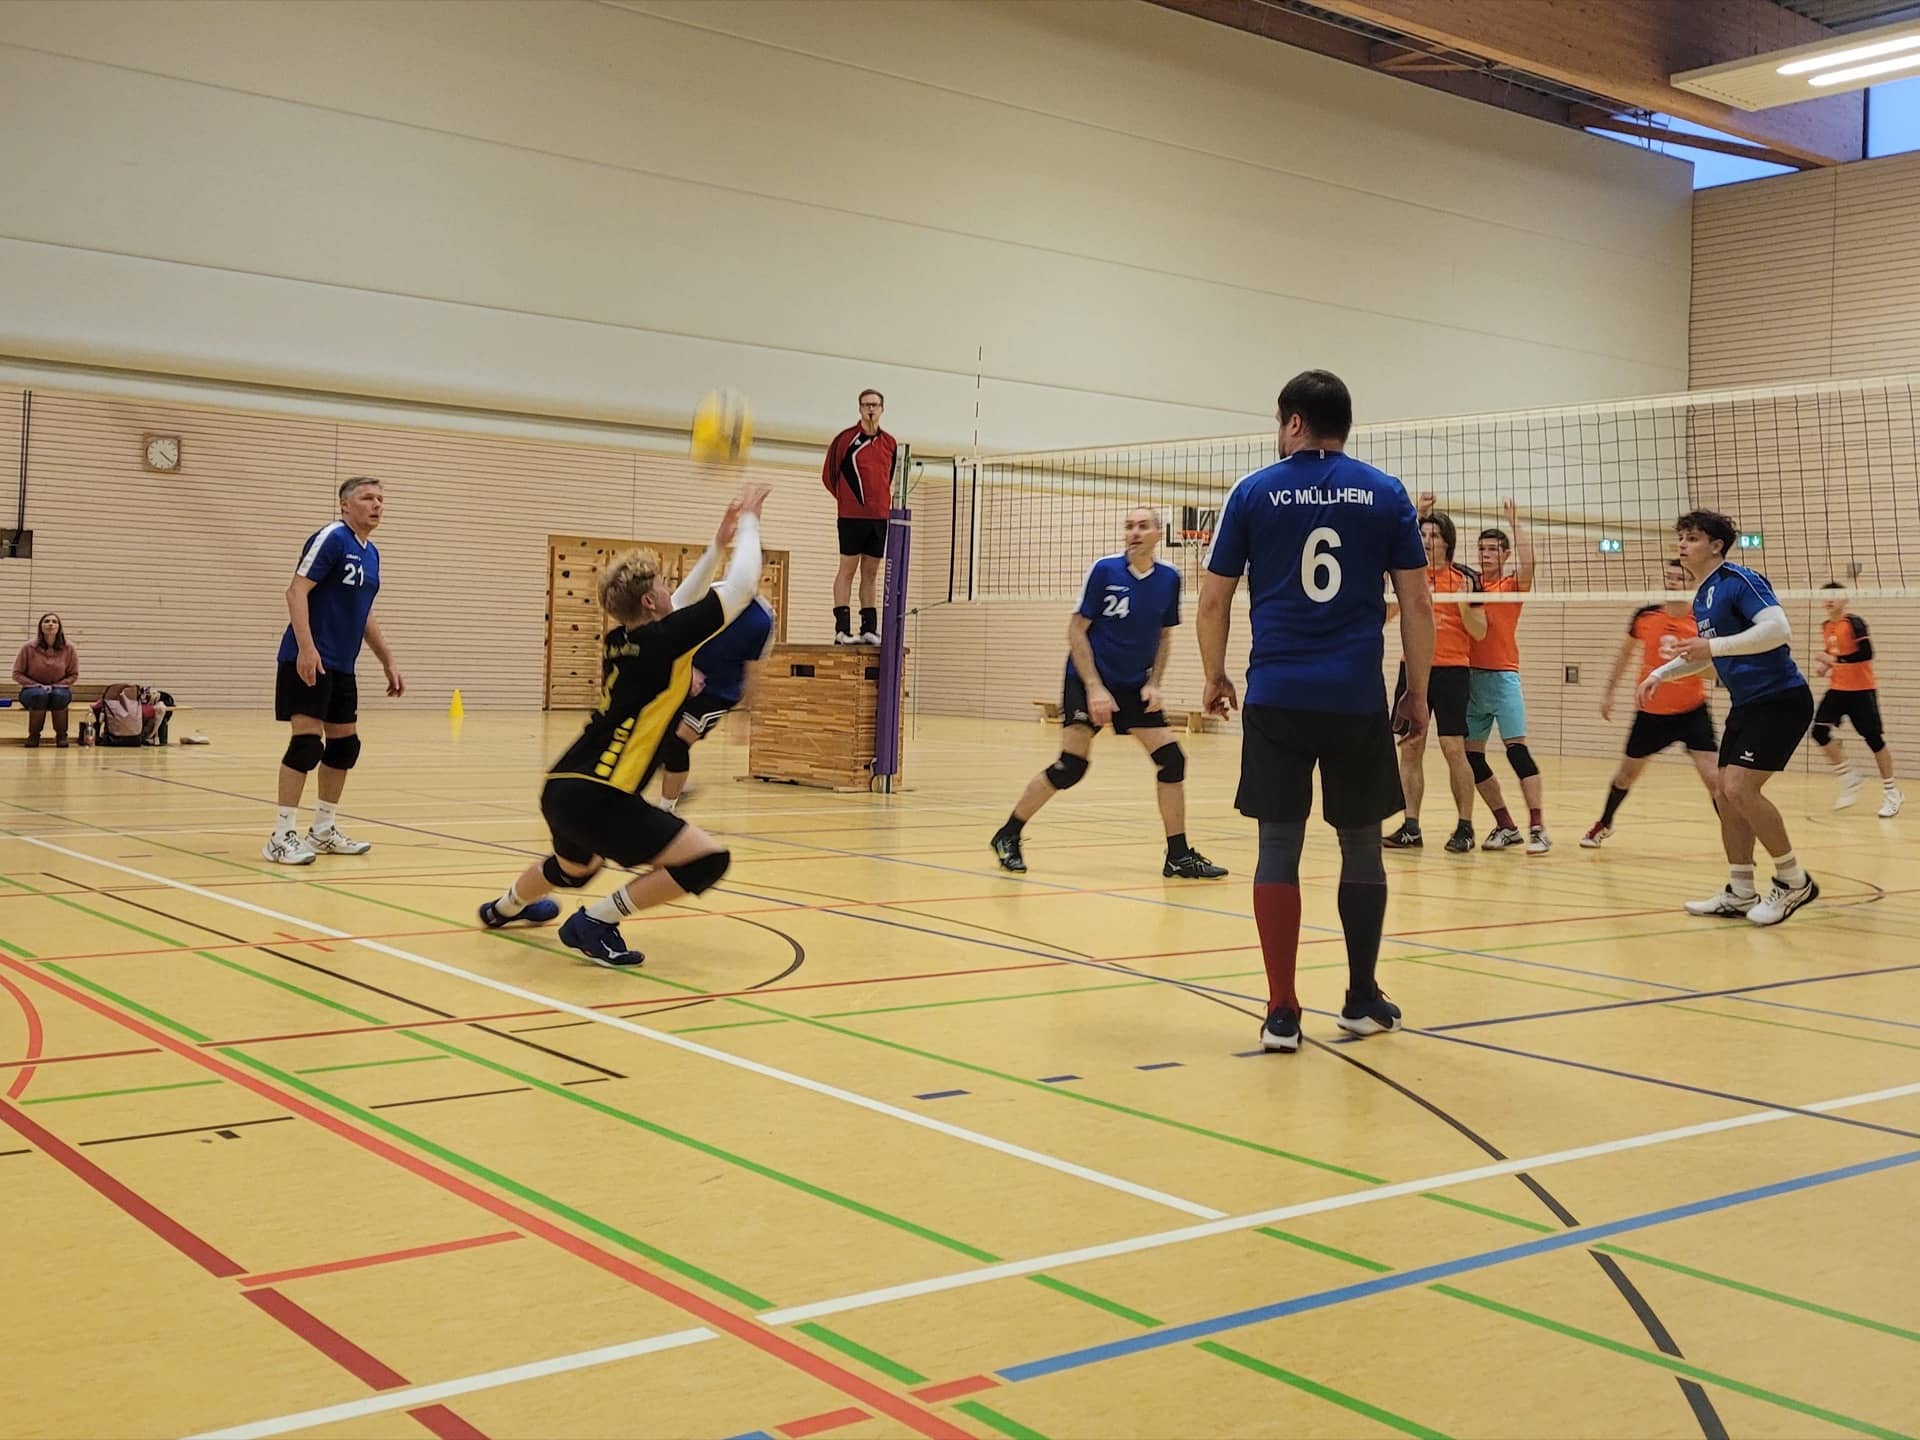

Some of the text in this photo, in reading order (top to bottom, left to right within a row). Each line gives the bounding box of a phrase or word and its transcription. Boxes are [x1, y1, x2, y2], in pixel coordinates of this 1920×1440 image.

[1269, 487, 1373, 507] VC MÜLLHEIM
[343, 563, 364, 587] 21
[1301, 526, 1342, 603] 6
[1103, 595, 1131, 619] 24
[1706, 586, 1715, 609] 8
